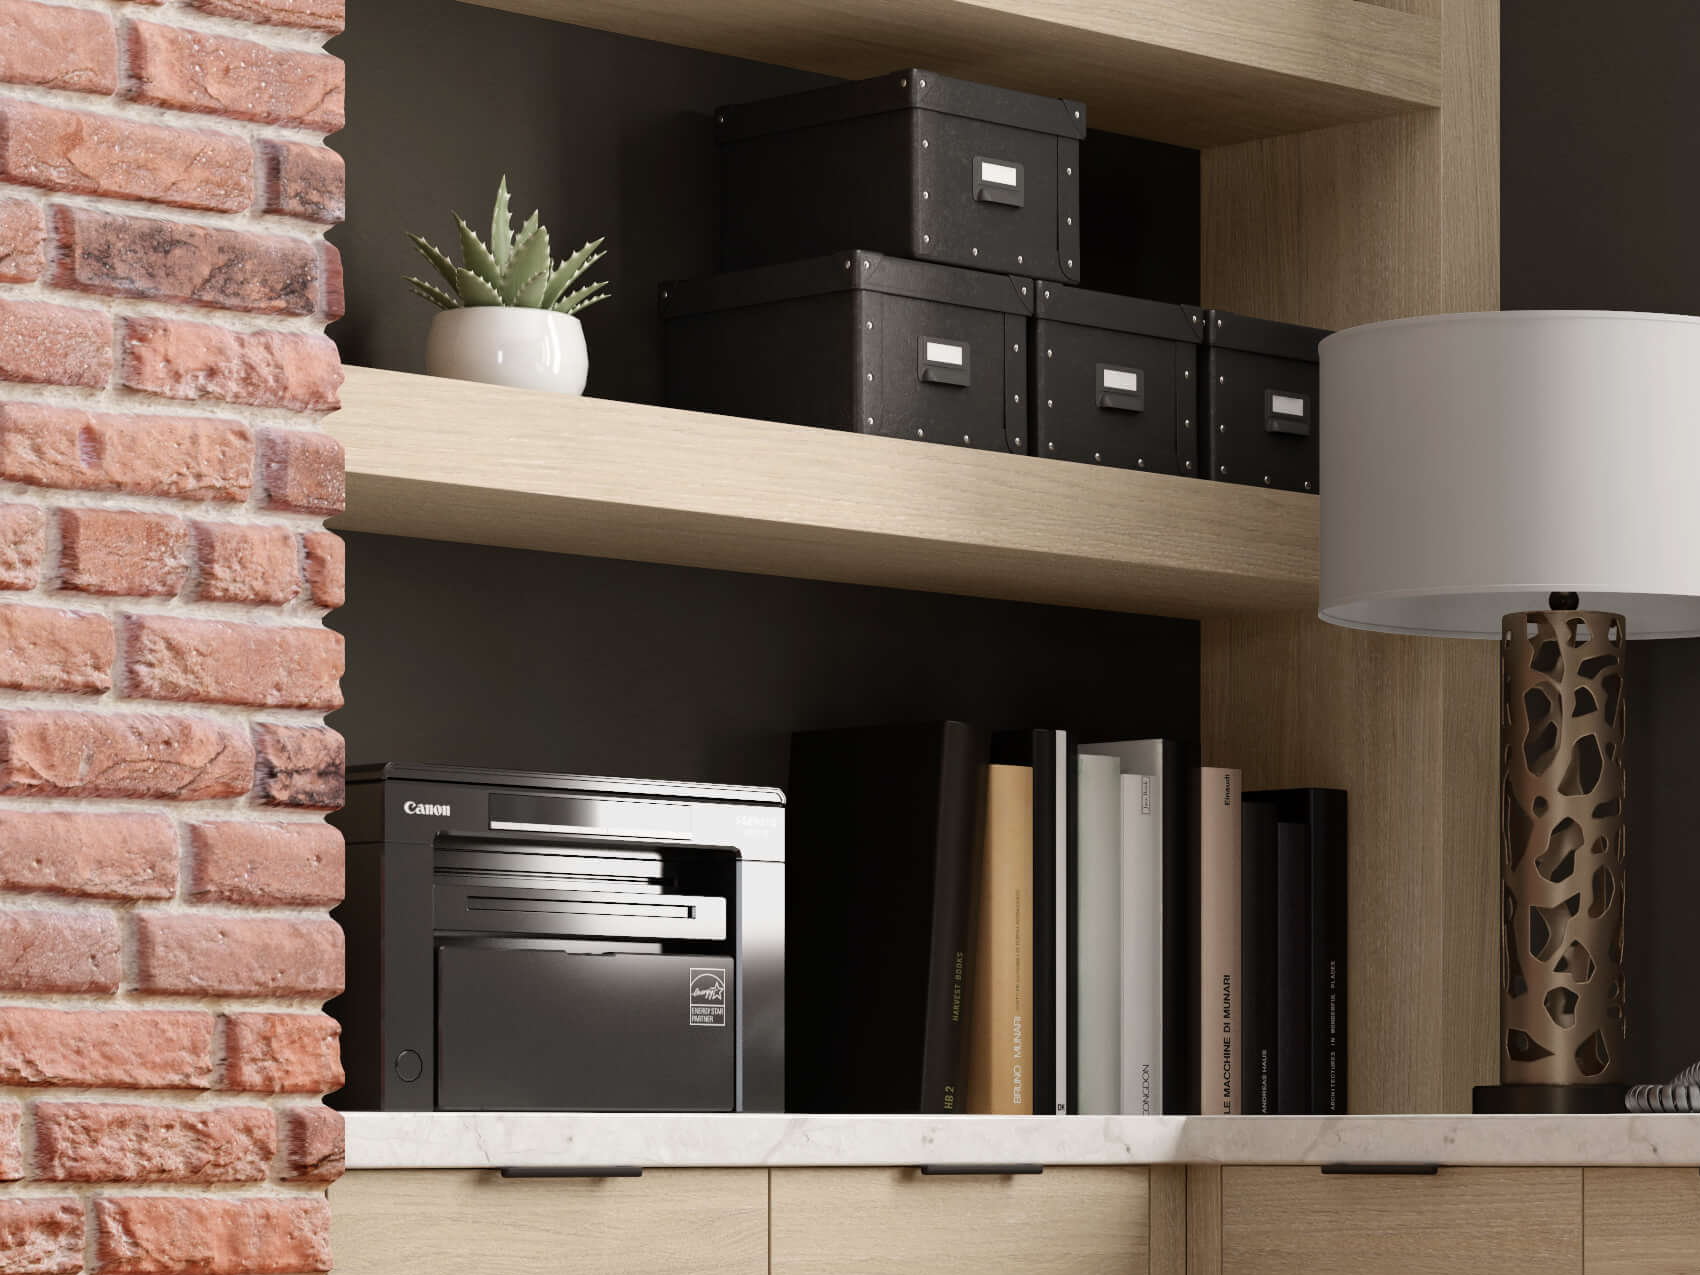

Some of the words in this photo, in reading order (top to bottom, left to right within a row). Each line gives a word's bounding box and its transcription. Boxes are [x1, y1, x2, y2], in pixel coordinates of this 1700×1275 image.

[403, 800, 451, 817] Canon
[955, 951, 963, 981] BOOKS
[952, 984, 960, 1022] HARVEST
[1013, 1016, 1022, 1059] MUNARI
[1223, 1022, 1230, 1033] DI
[1013, 1064, 1022, 1105] BRUNO
[1223, 1100, 1230, 1115] LE
